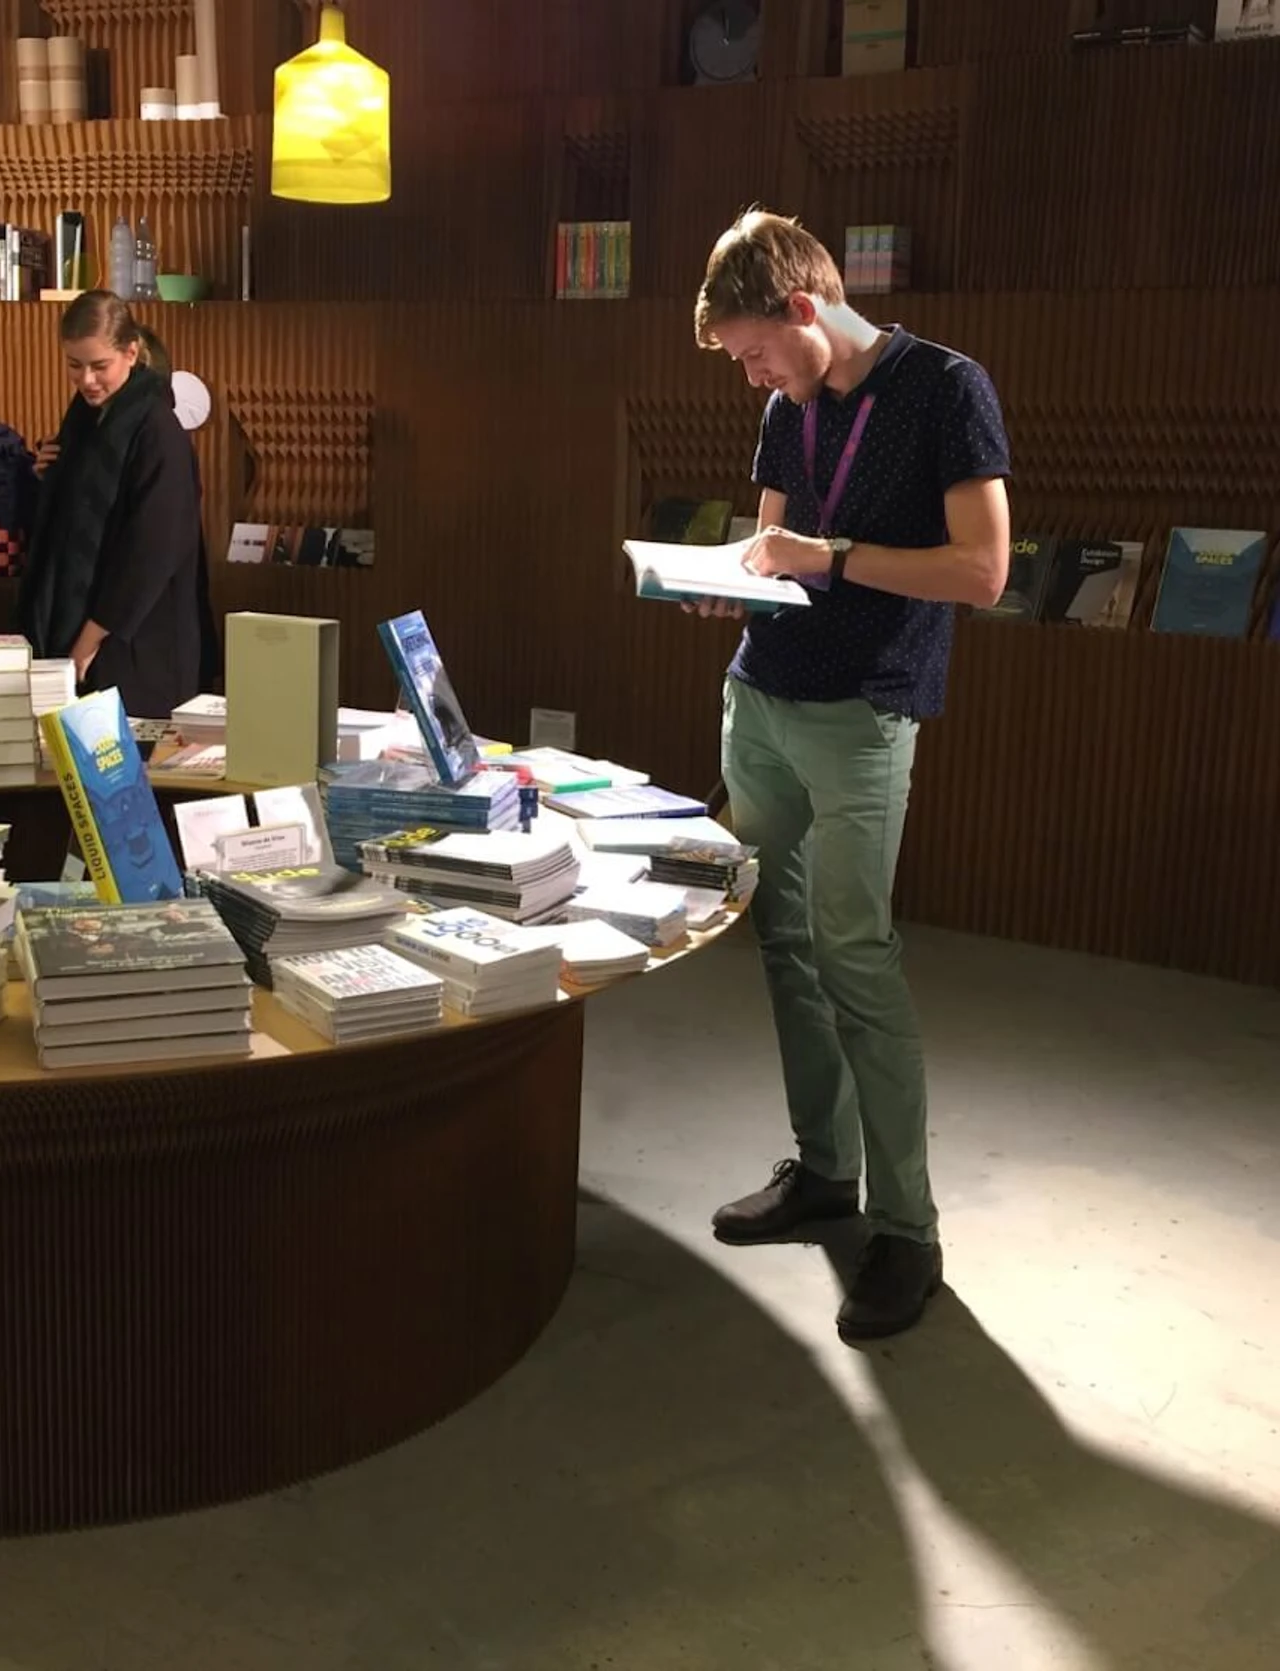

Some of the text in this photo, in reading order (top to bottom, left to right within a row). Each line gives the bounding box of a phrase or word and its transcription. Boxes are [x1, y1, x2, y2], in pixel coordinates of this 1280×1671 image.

[63, 771, 107, 880] LIQUID SPACES
[229, 867, 320, 885] dude
[284, 949, 343, 967] HOW
